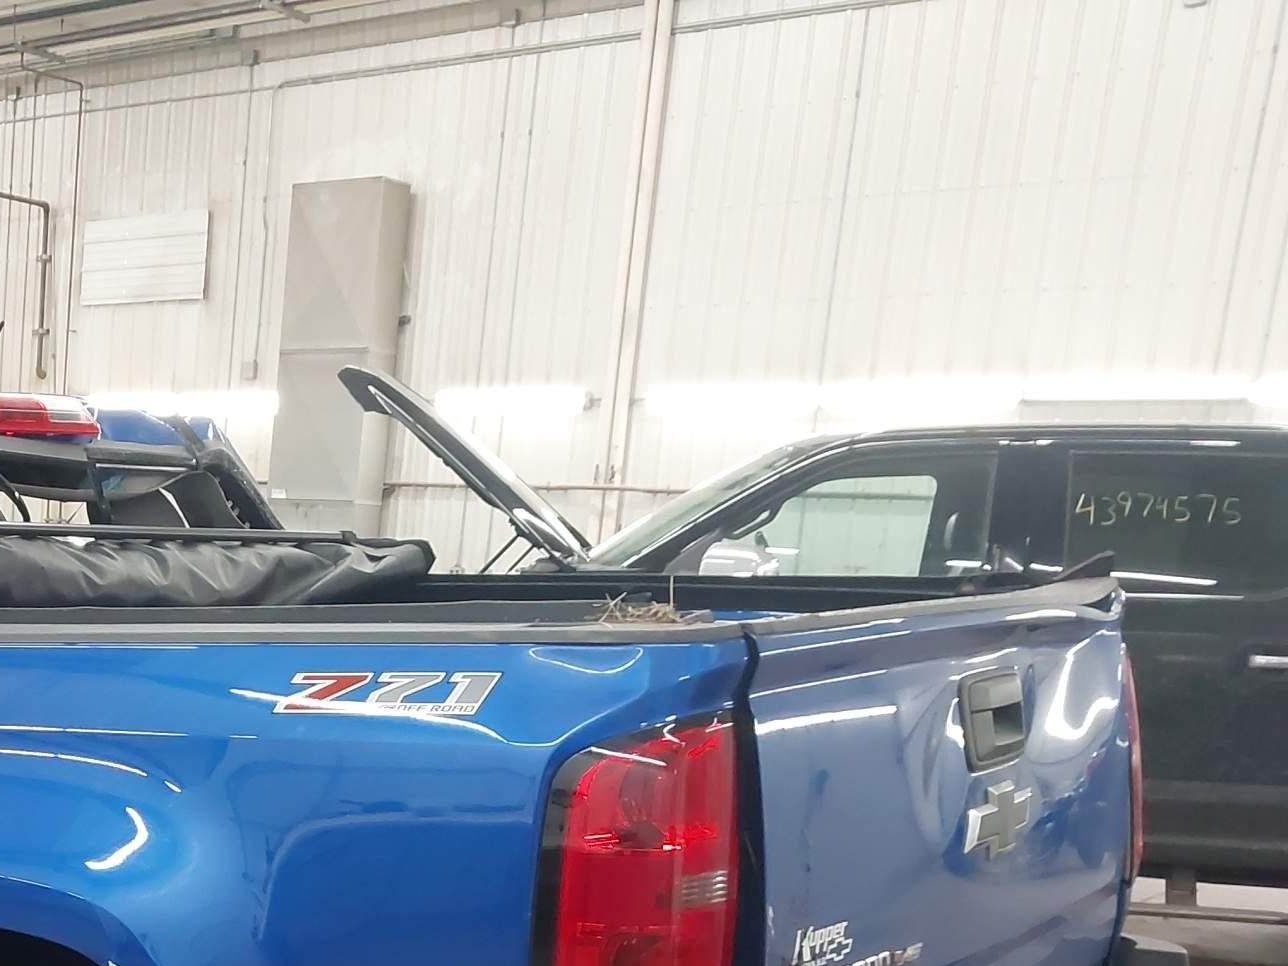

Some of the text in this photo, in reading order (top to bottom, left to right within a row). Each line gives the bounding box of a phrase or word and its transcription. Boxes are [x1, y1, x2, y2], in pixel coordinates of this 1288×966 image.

[1075, 490, 1242, 526] 43974575
[272, 671, 504, 716] Z71
[430, 704, 476, 713] ROAD
[792, 920, 849, 966] Kupper
